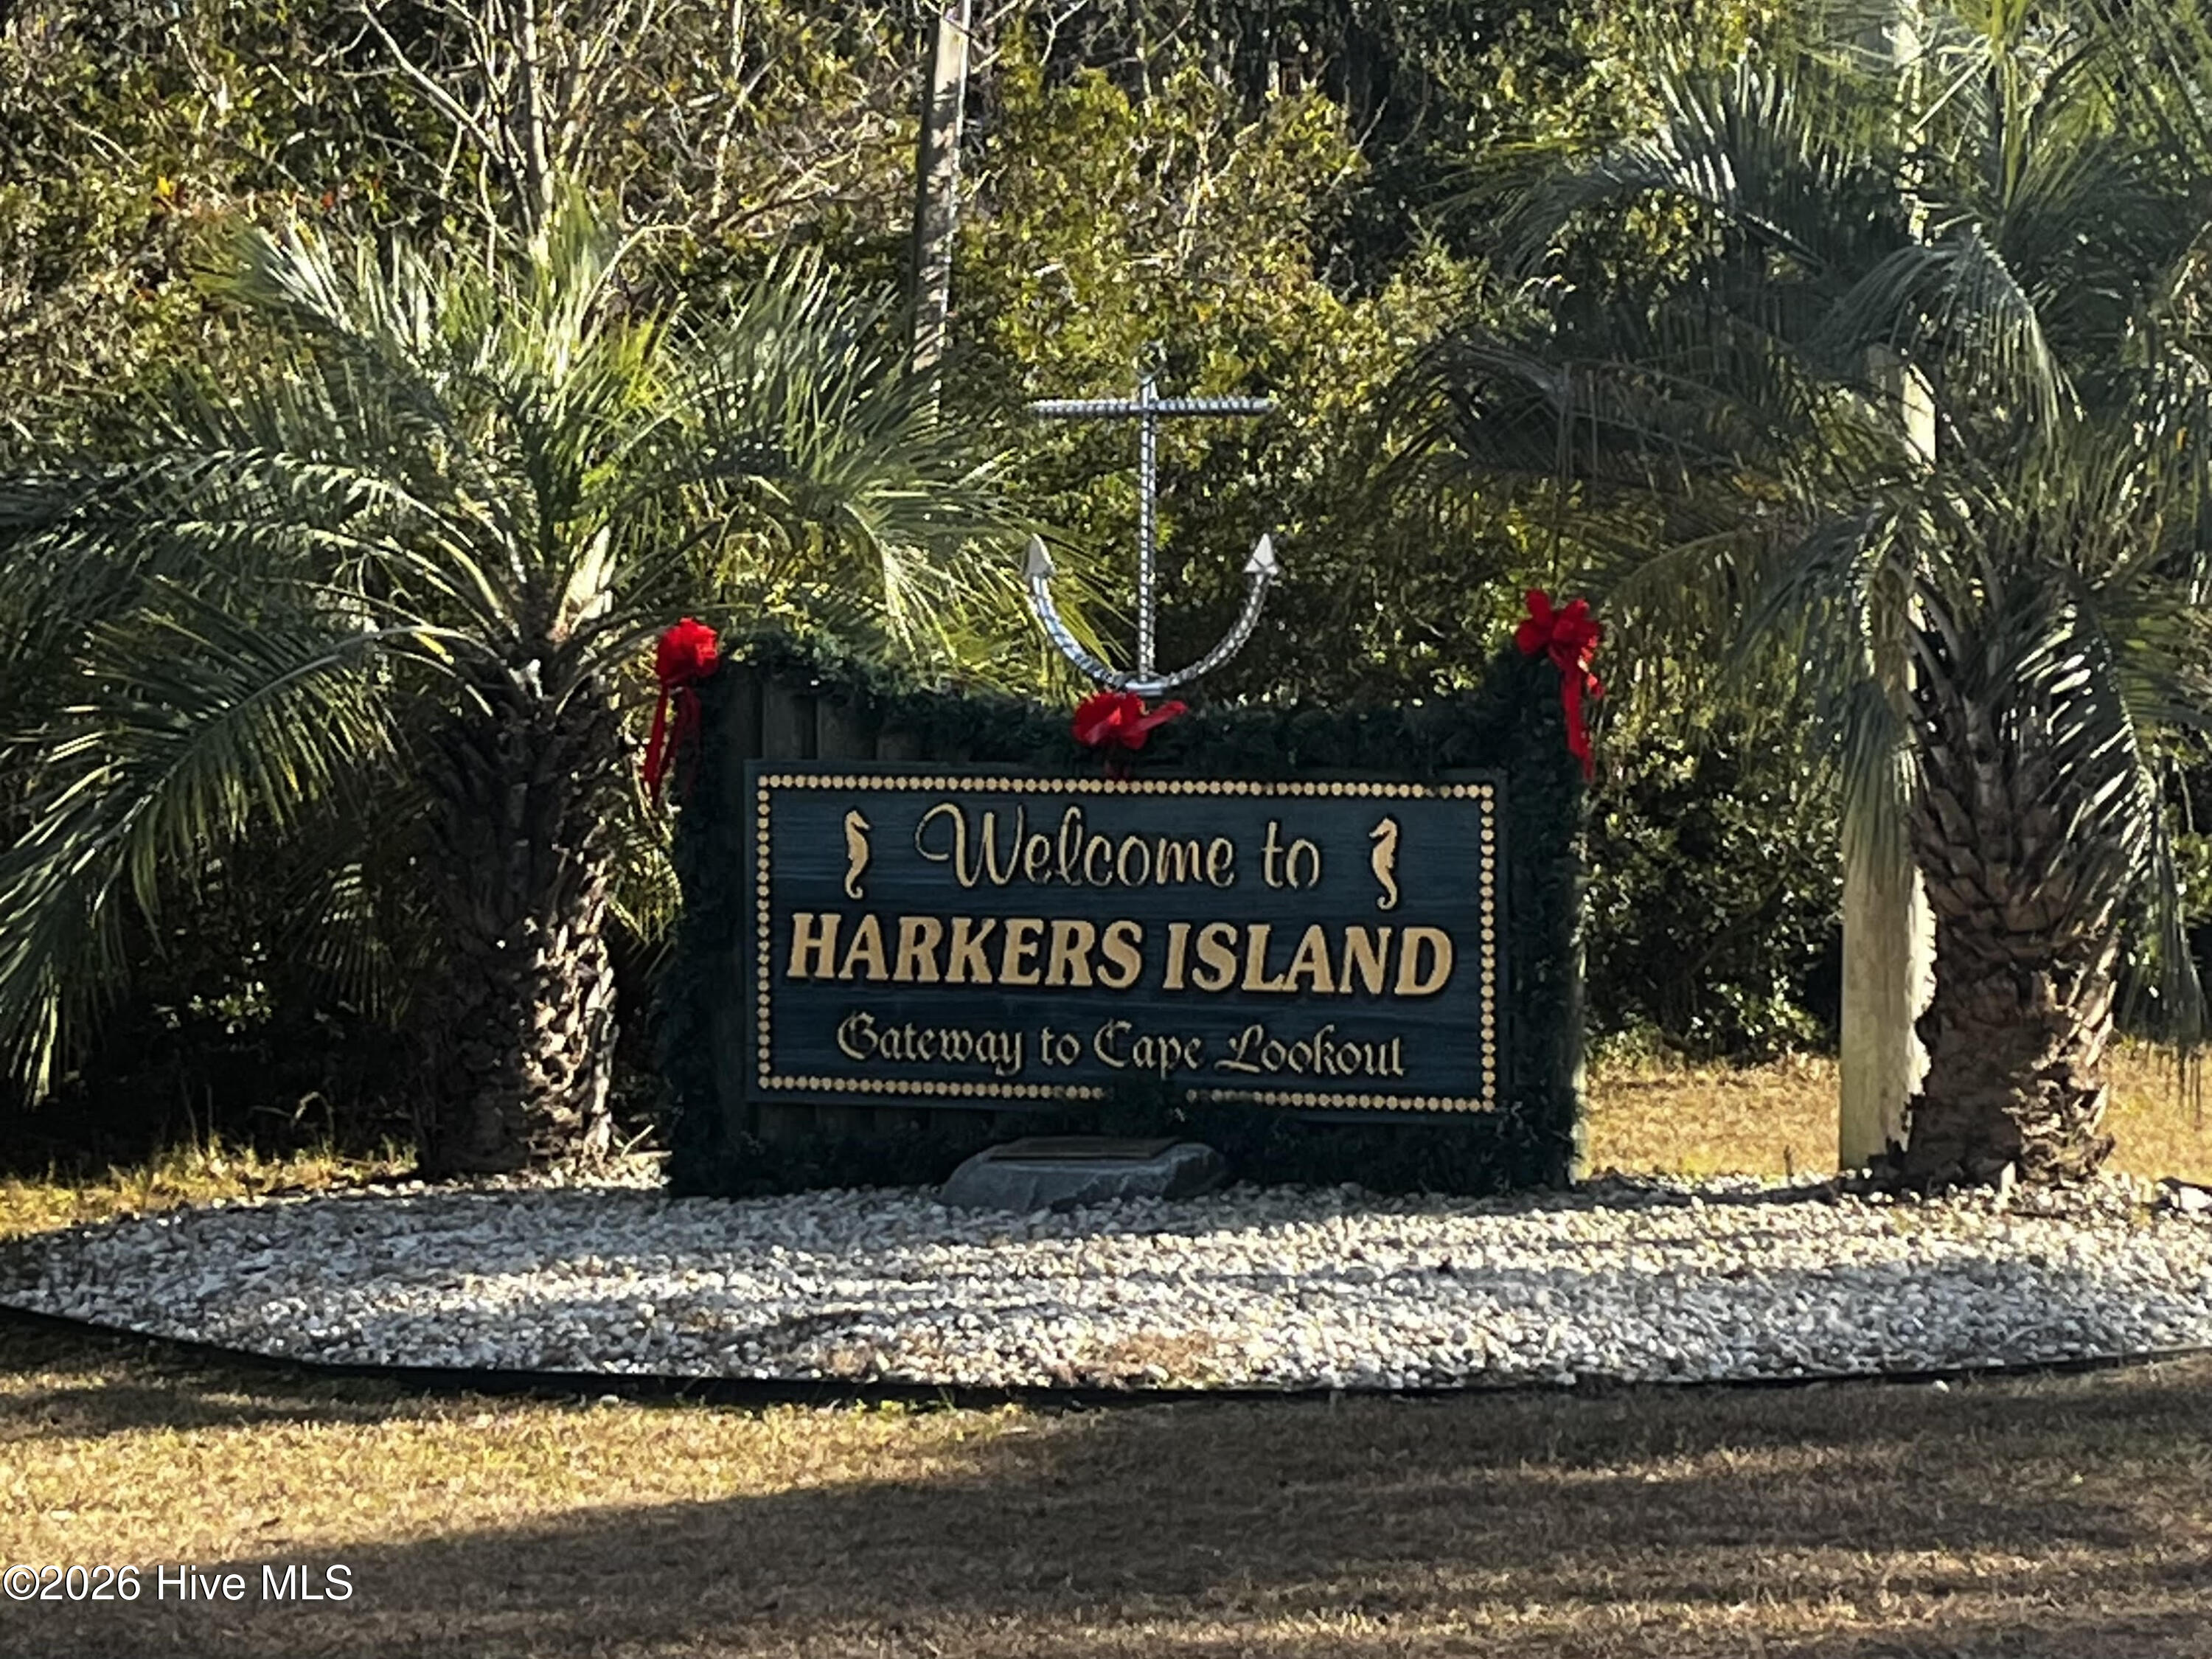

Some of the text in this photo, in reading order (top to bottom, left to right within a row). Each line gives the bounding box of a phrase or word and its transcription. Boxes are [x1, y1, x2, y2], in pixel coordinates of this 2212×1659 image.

[914, 802, 1321, 889] Welcome to
[787, 912, 1454, 995] HARKERS ISLAND
[837, 1011, 1405, 1079] Gateway to Cape Lookout
